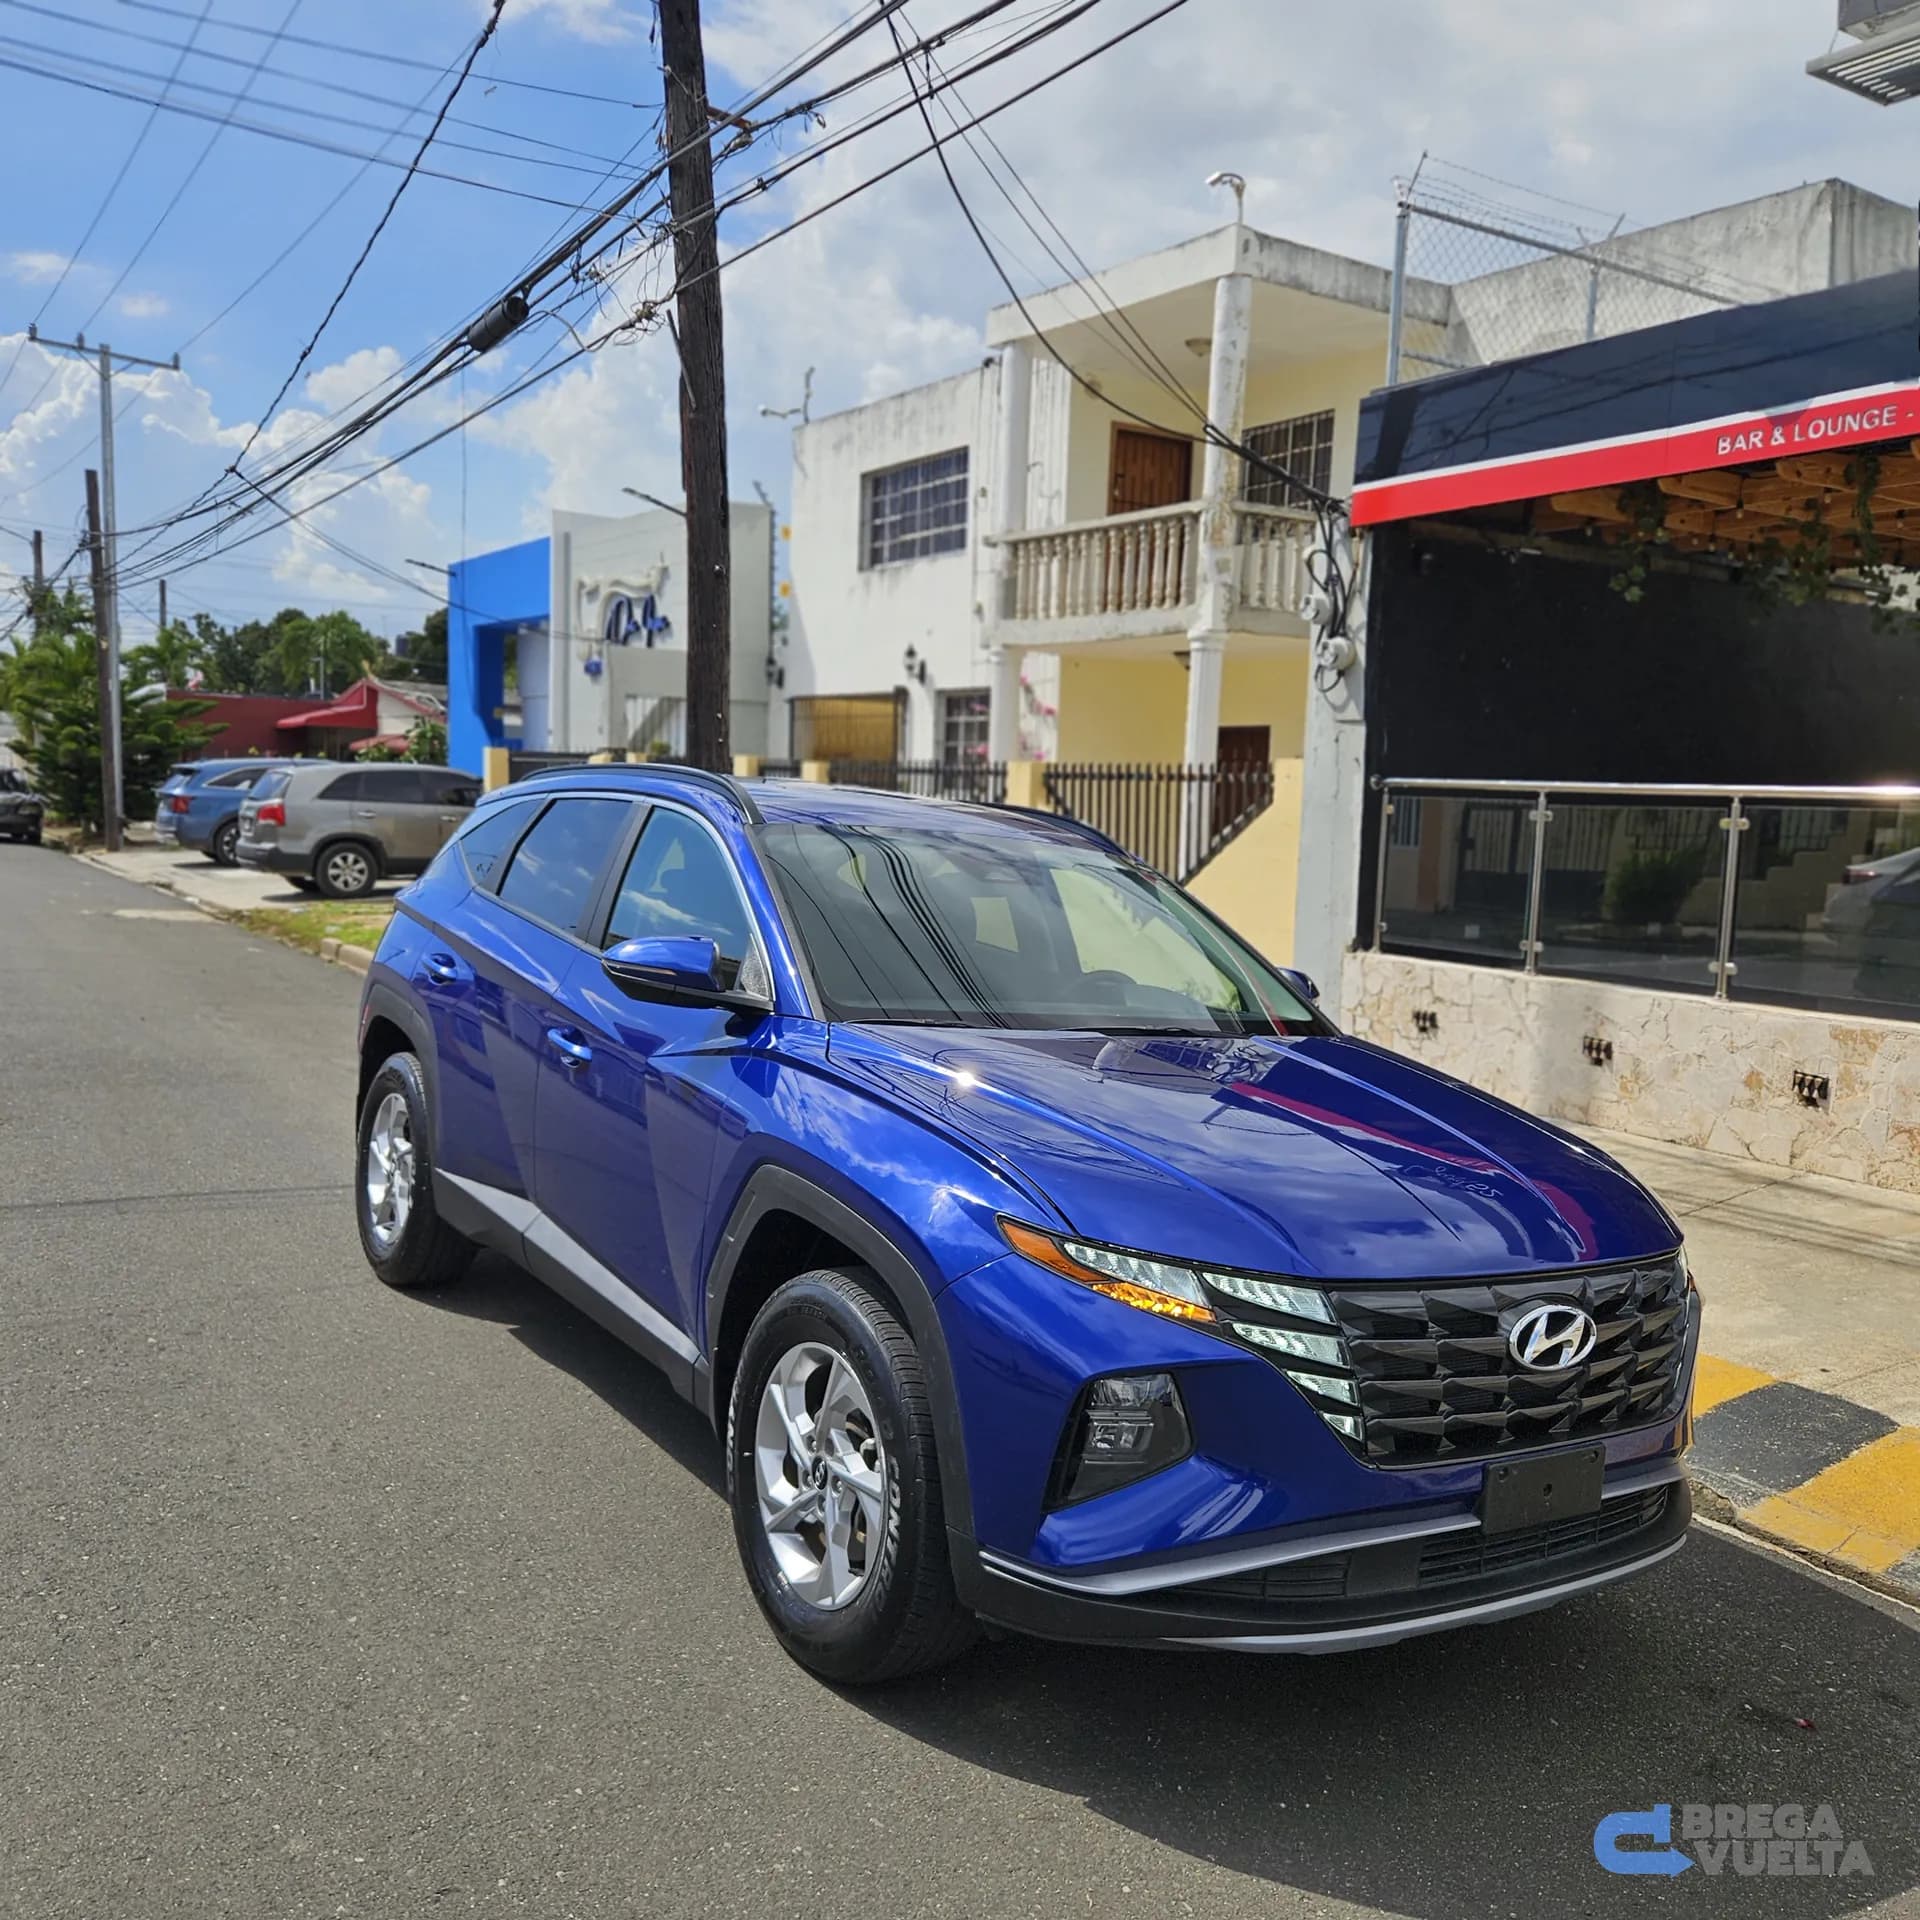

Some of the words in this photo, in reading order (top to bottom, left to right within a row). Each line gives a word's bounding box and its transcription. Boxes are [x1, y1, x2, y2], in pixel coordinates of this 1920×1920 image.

[1717, 431, 1764, 455] BAR
[1770, 426, 1785, 446] &
[1794, 405, 1898, 442] LOUNGE
